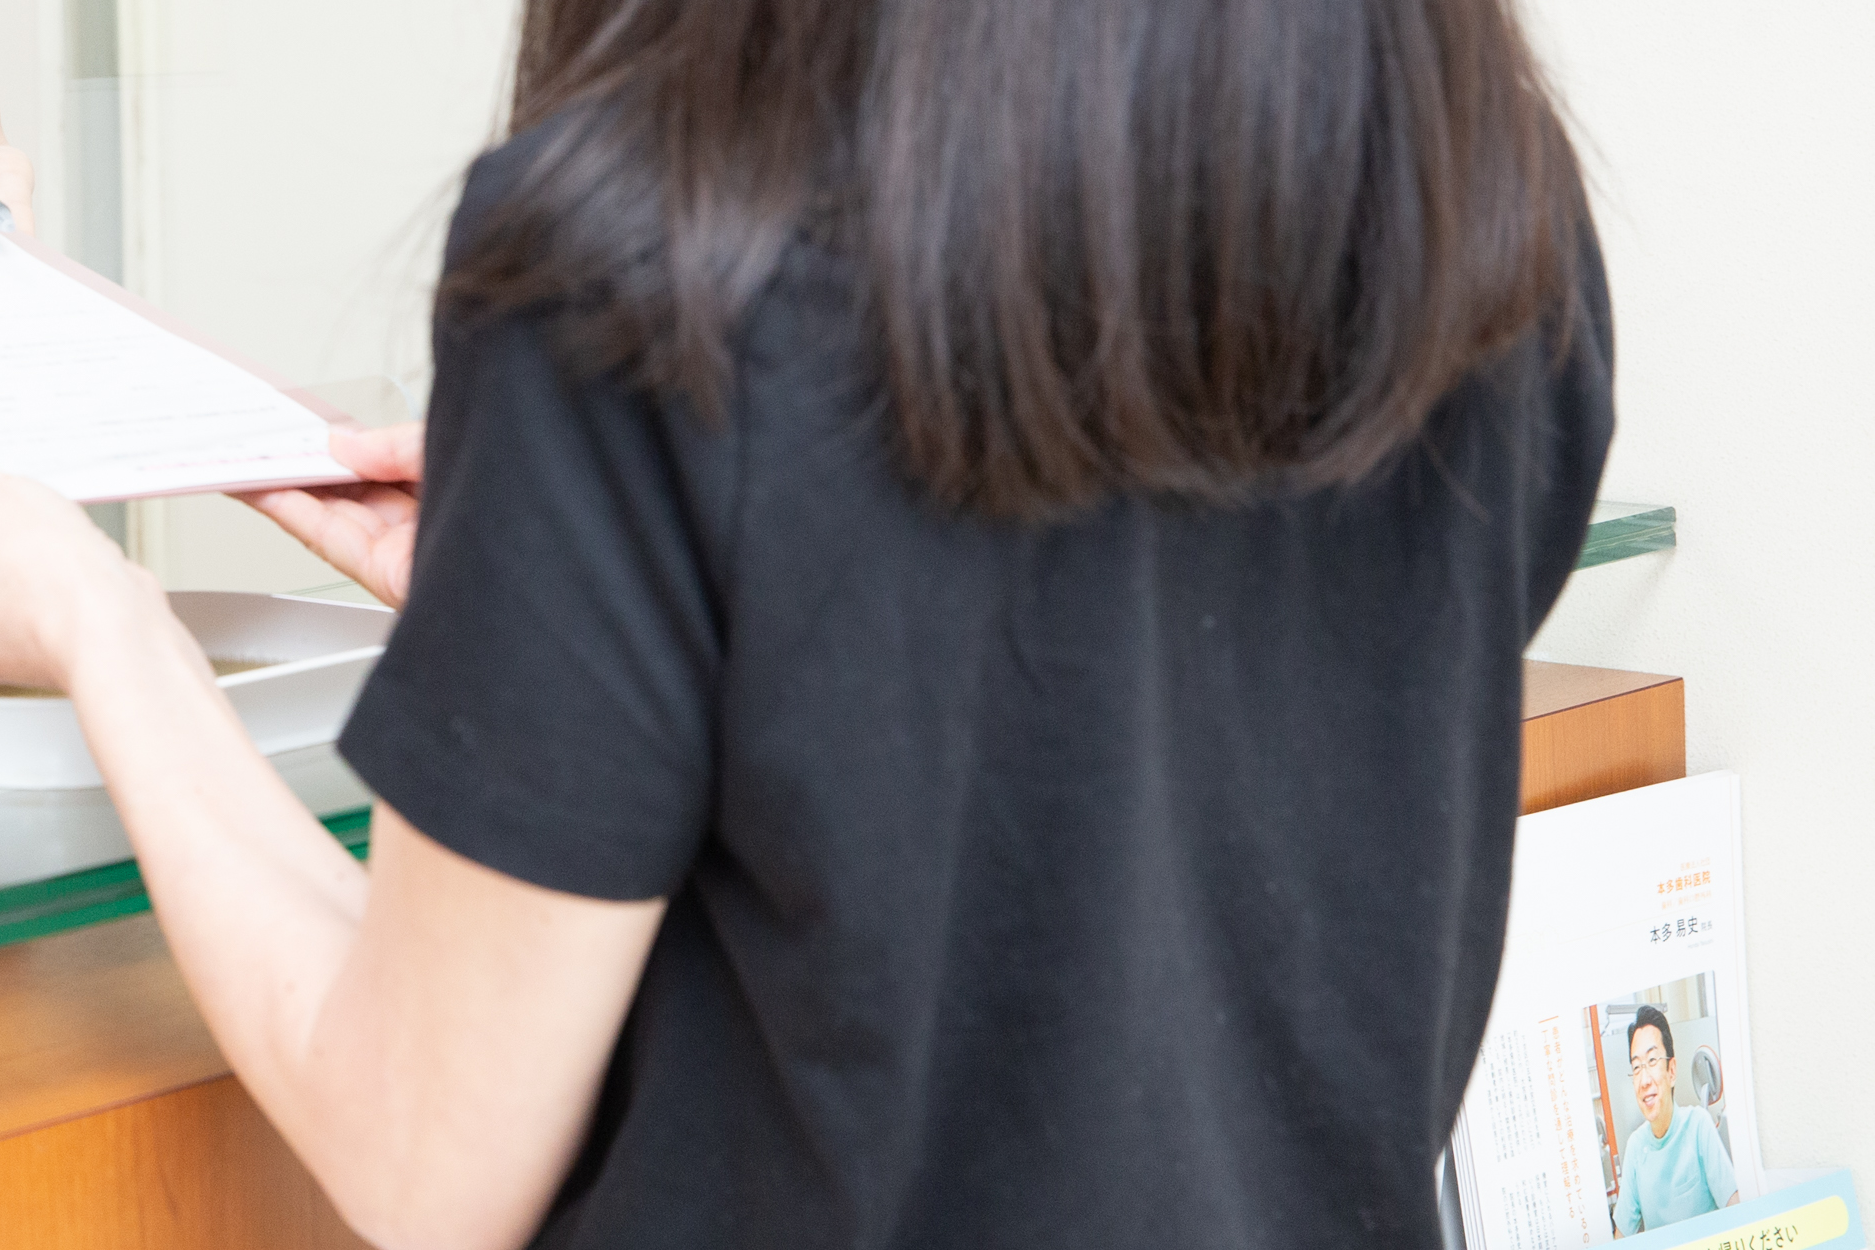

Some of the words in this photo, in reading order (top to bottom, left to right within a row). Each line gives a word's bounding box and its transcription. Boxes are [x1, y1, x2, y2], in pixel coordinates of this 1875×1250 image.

[1657, 870, 1711, 895] 本多歯科医院
[1650, 923, 1672, 945] 本多
[1676, 916, 1699, 938] 易史
[1552, 1026, 1590, 1247] 患者がどんな治療を求めているの
